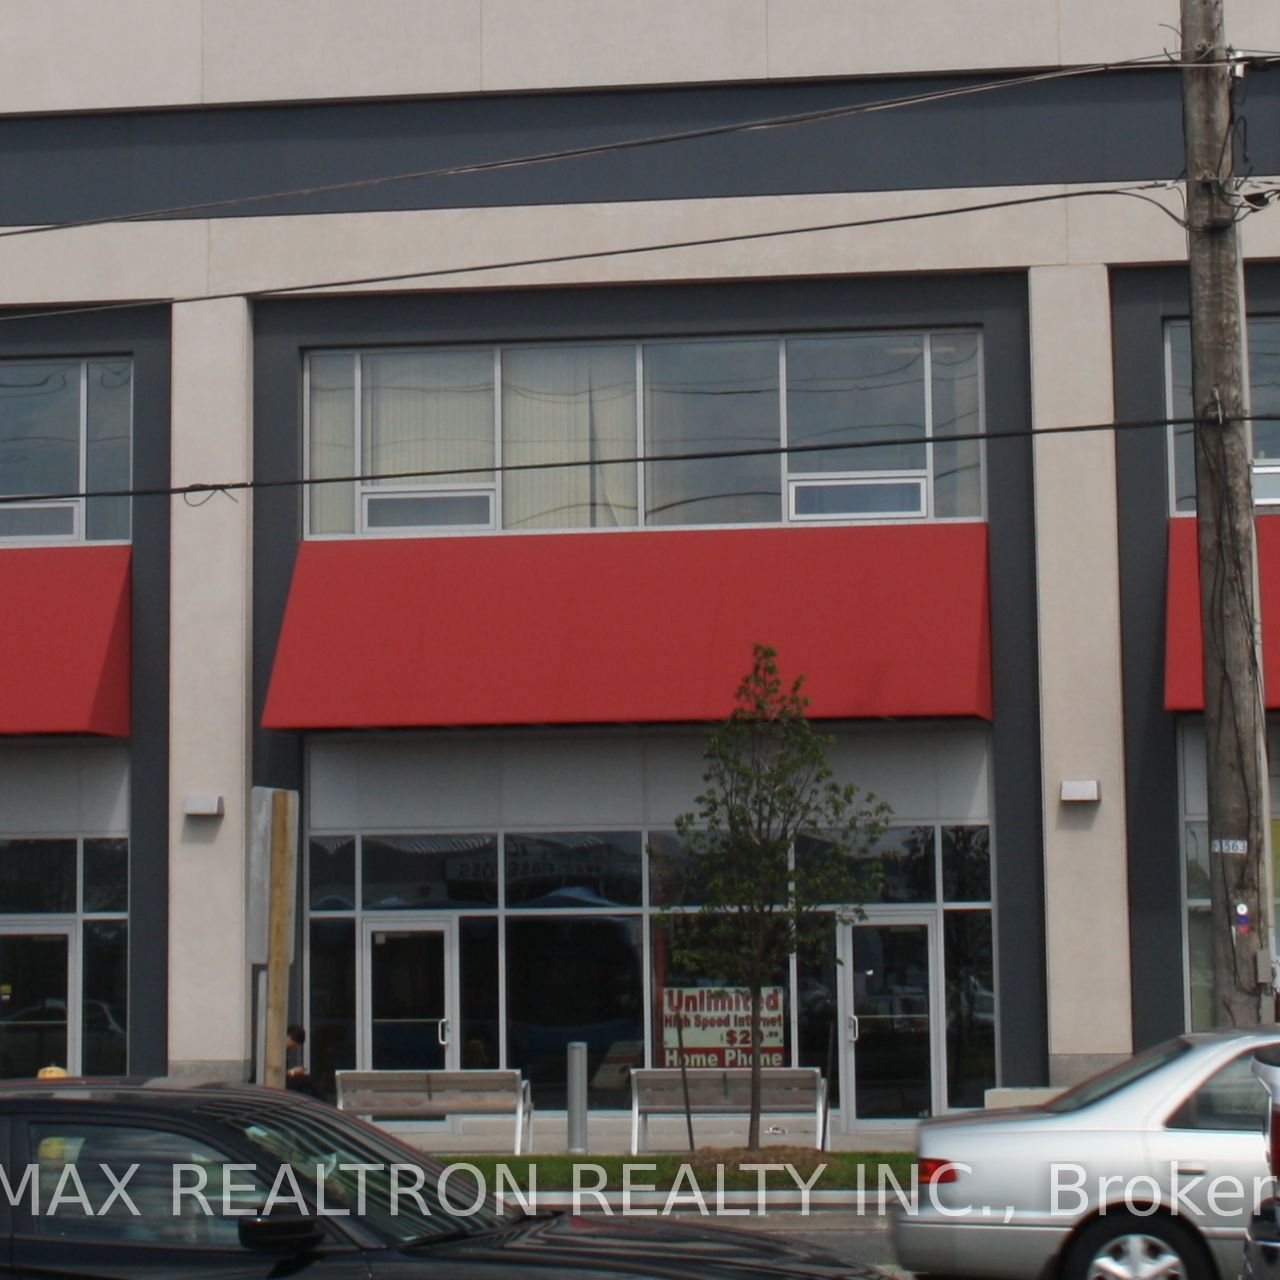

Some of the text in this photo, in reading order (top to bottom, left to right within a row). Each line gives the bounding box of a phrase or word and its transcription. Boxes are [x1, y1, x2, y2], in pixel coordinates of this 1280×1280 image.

[668, 989, 780, 1012] Unlimitd
[664, 1014, 783, 1030] Hih Speed Intnet
